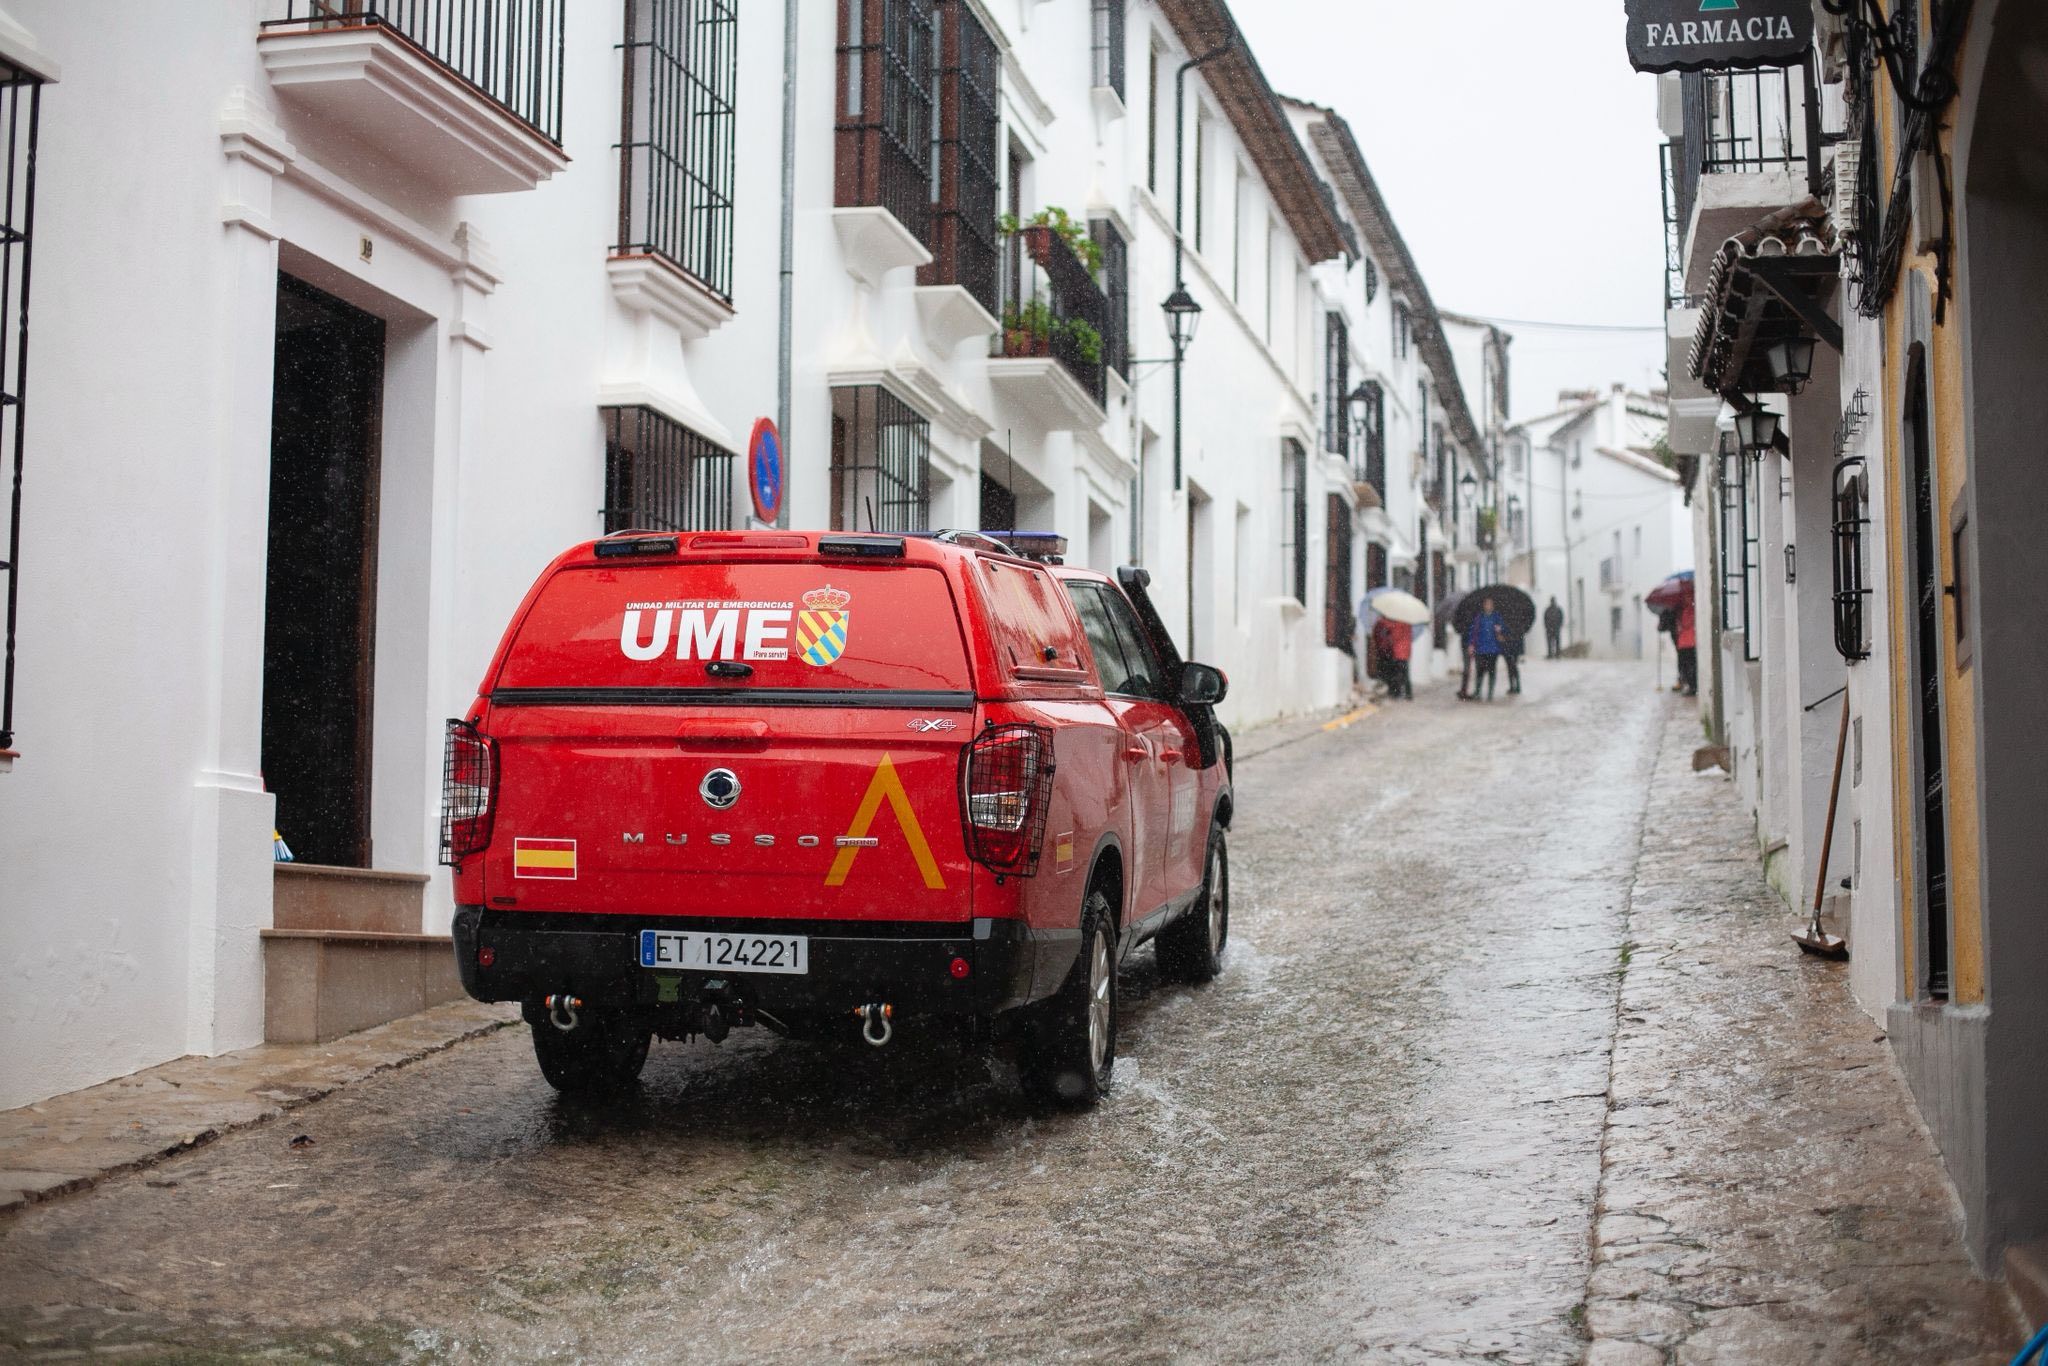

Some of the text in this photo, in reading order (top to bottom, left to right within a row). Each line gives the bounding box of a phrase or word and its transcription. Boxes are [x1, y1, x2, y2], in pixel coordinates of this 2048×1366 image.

[1646, 15, 1794, 47] FARMACIA
[626, 601, 794, 610] UNIDAD MILITAR DE EMERGENCIAS
[620, 610, 792, 661] UME
[622, 832, 820, 847] MUSSO
[656, 935, 799, 968] ET 124221
